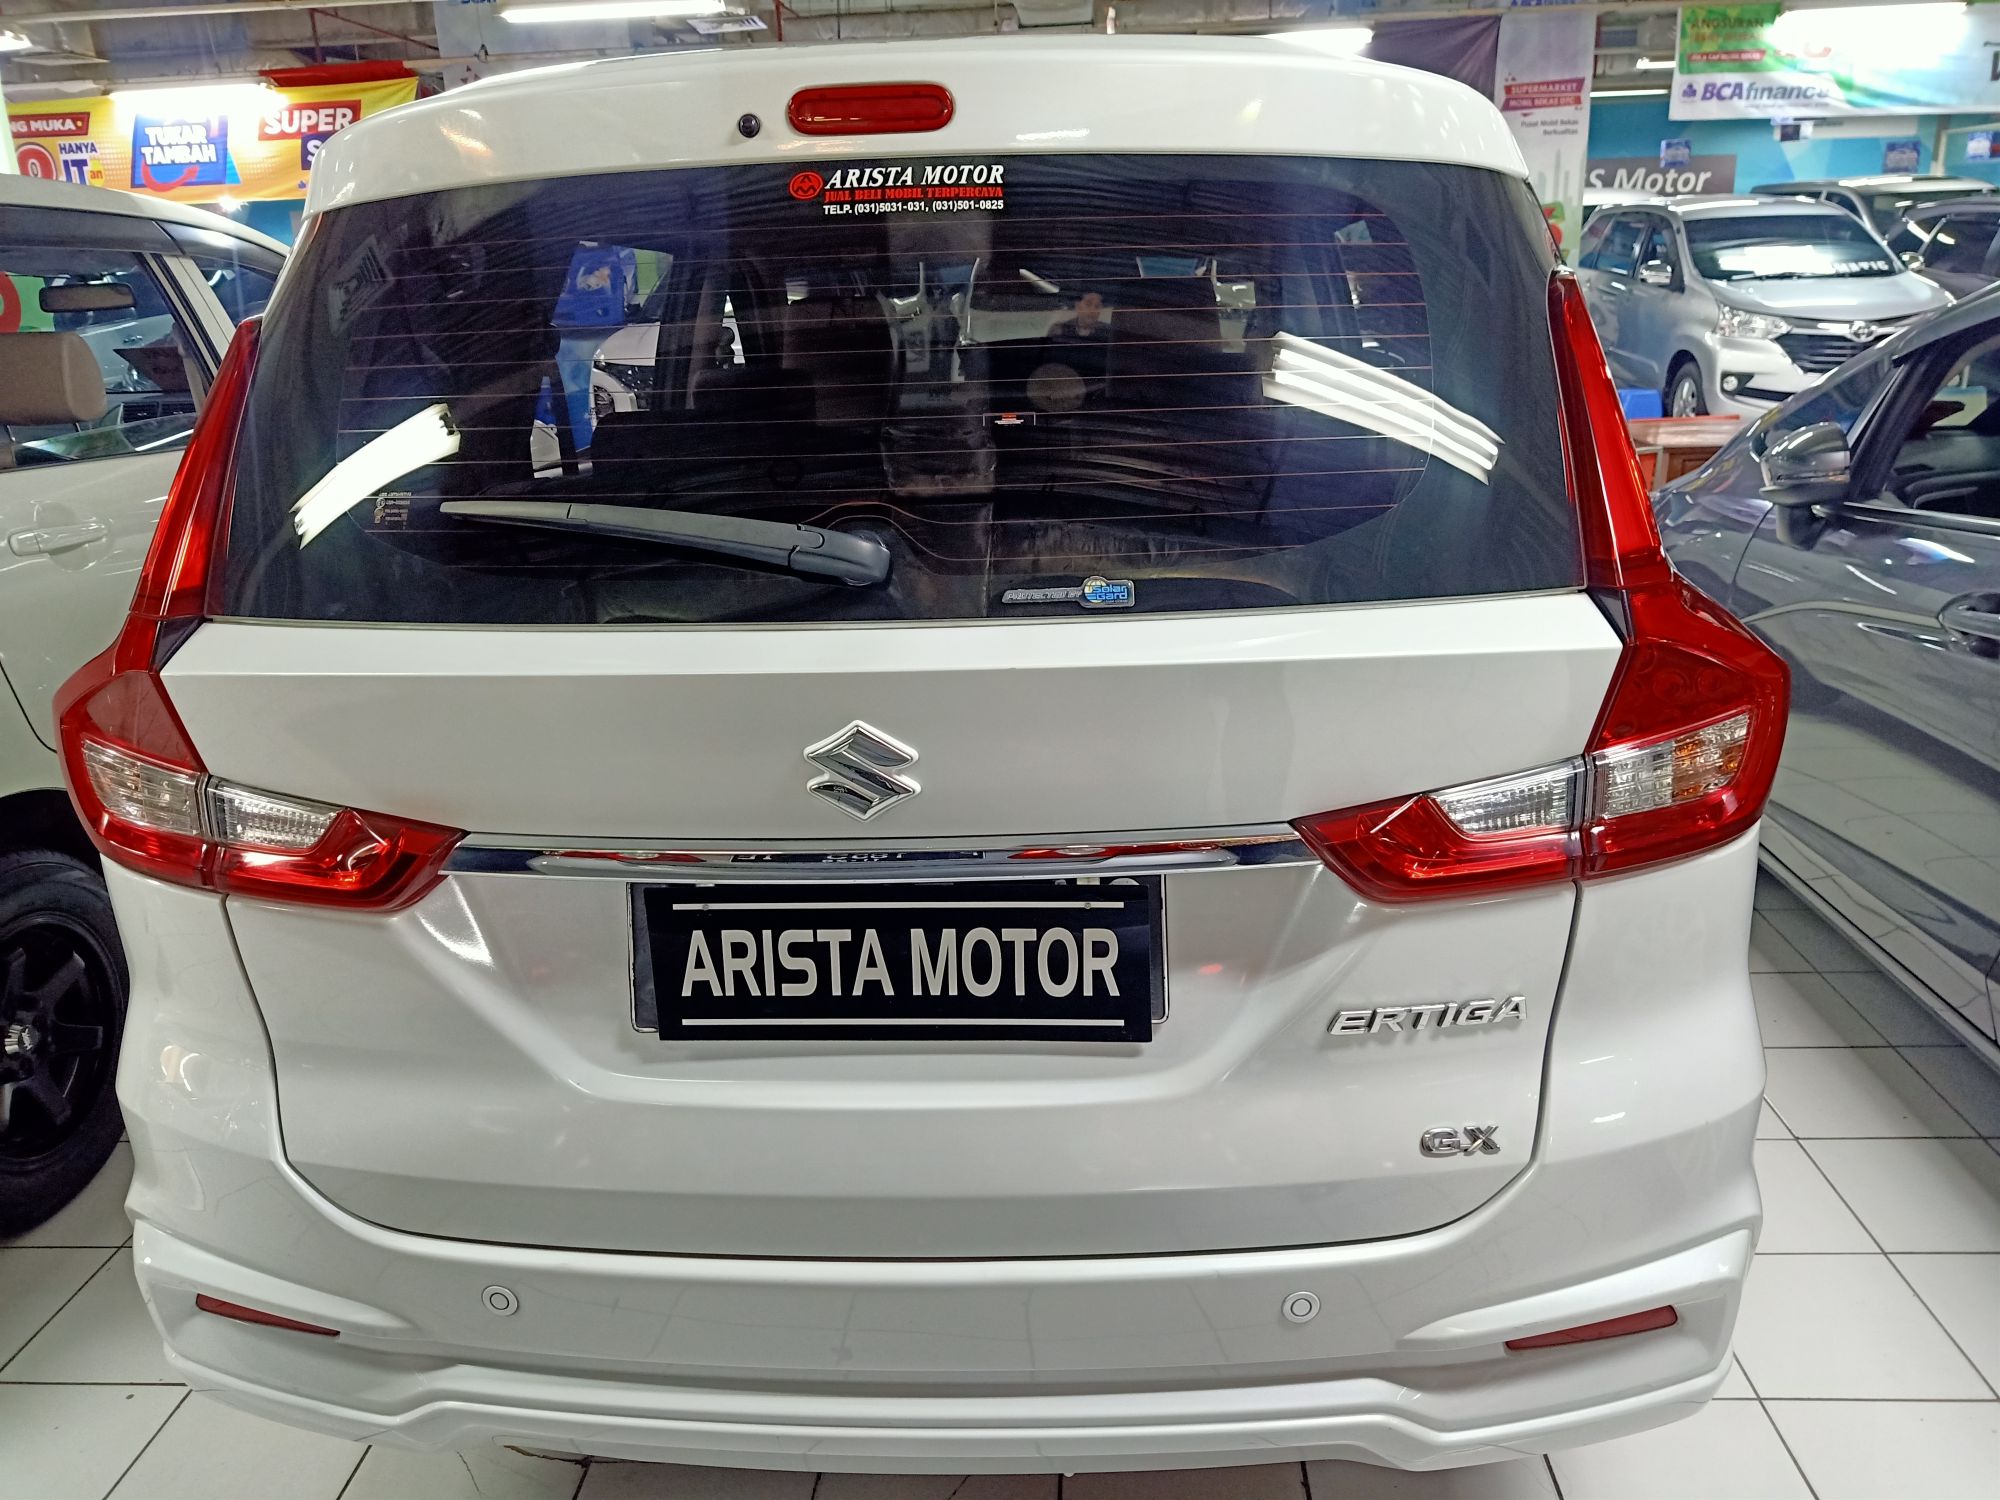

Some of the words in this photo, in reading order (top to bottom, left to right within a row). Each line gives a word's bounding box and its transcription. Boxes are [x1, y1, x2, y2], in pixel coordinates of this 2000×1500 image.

[30, 118, 76, 131] MUKA
[264, 108, 353, 135] SUPER
[58, 141, 98, 154] HANYA
[144, 124, 208, 147] TUKAR
[141, 143, 218, 166] TAMBAH
[824, 166, 914, 190] ARISTA
[920, 164, 1004, 185] MOTOR
[1612, 167, 1712, 193] Motor
[824, 188, 852, 203] JUAL
[854, 189, 883, 200] BELI
[885, 188, 924, 200] MOBIL
[927, 186, 1003, 199] TERPERCAYA
[823, 204, 852, 215] TELP.
[854, 202, 929, 215] (031)5031-031,
[932, 200, 1004, 212] (031)501-0825
[681, 928, 895, 997] ARISTA
[910, 926, 1120, 998] MOTOR
[1327, 996, 1528, 1036] ERTIGA
[1419, 1125, 1501, 1157] GX
